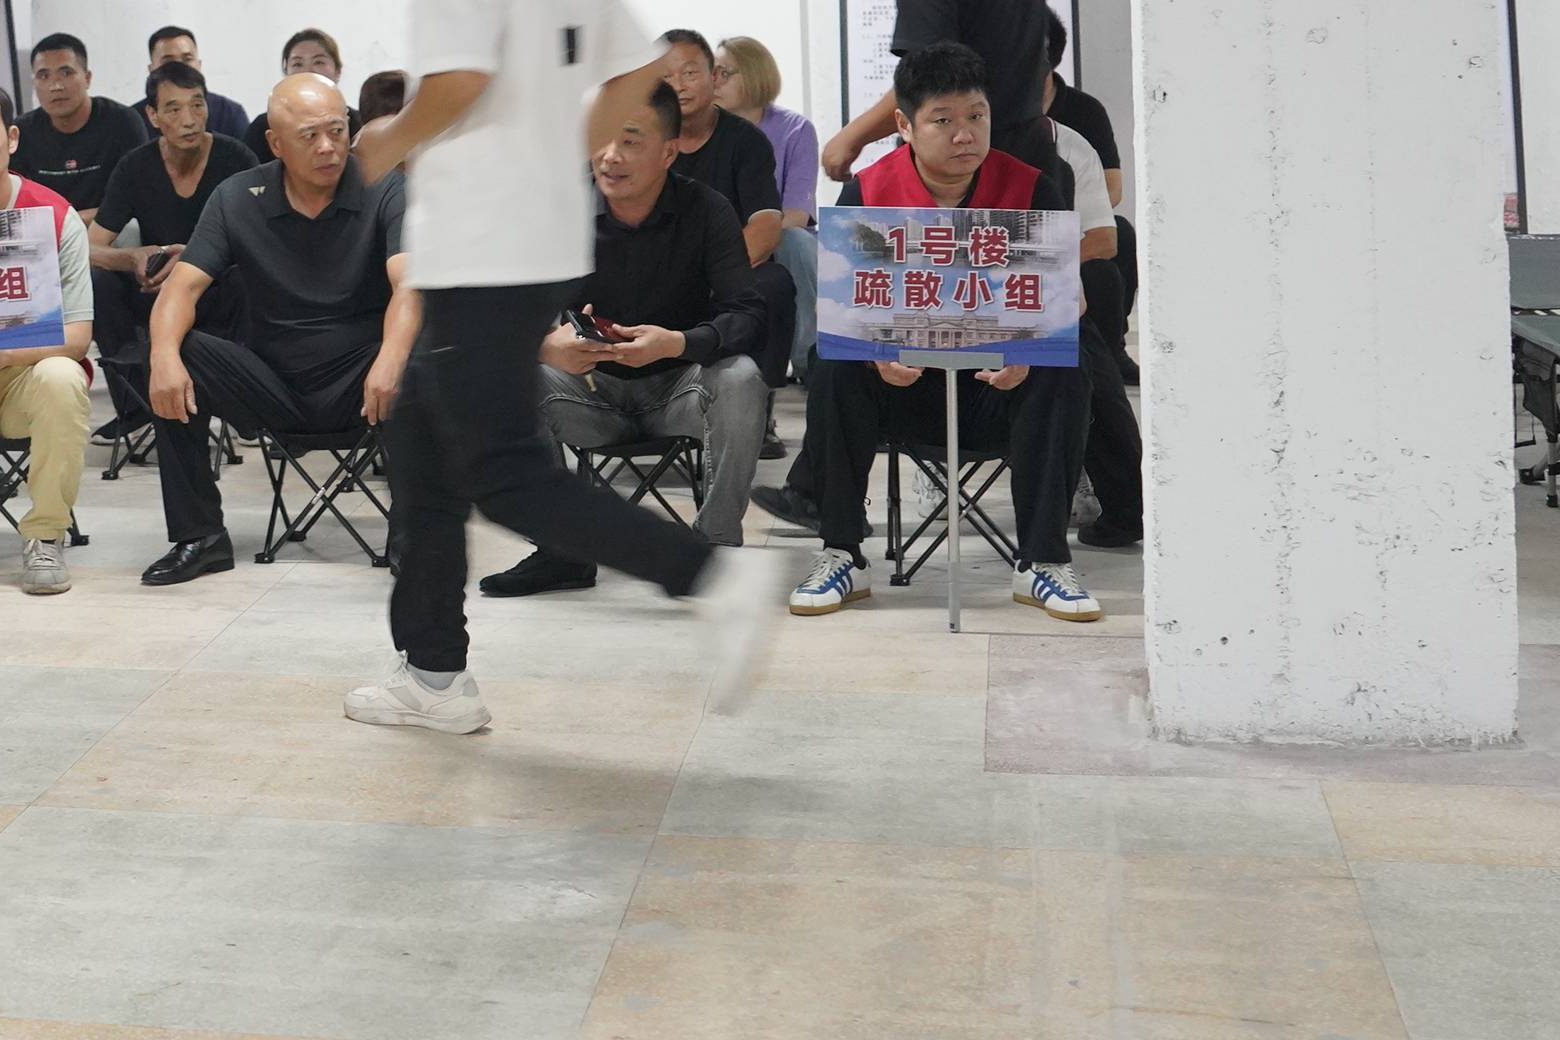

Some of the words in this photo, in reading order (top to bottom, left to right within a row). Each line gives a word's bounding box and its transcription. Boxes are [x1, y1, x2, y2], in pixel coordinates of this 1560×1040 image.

[887, 225, 1011, 267] 1号楼
[853, 269, 1044, 311] 疏散小组
